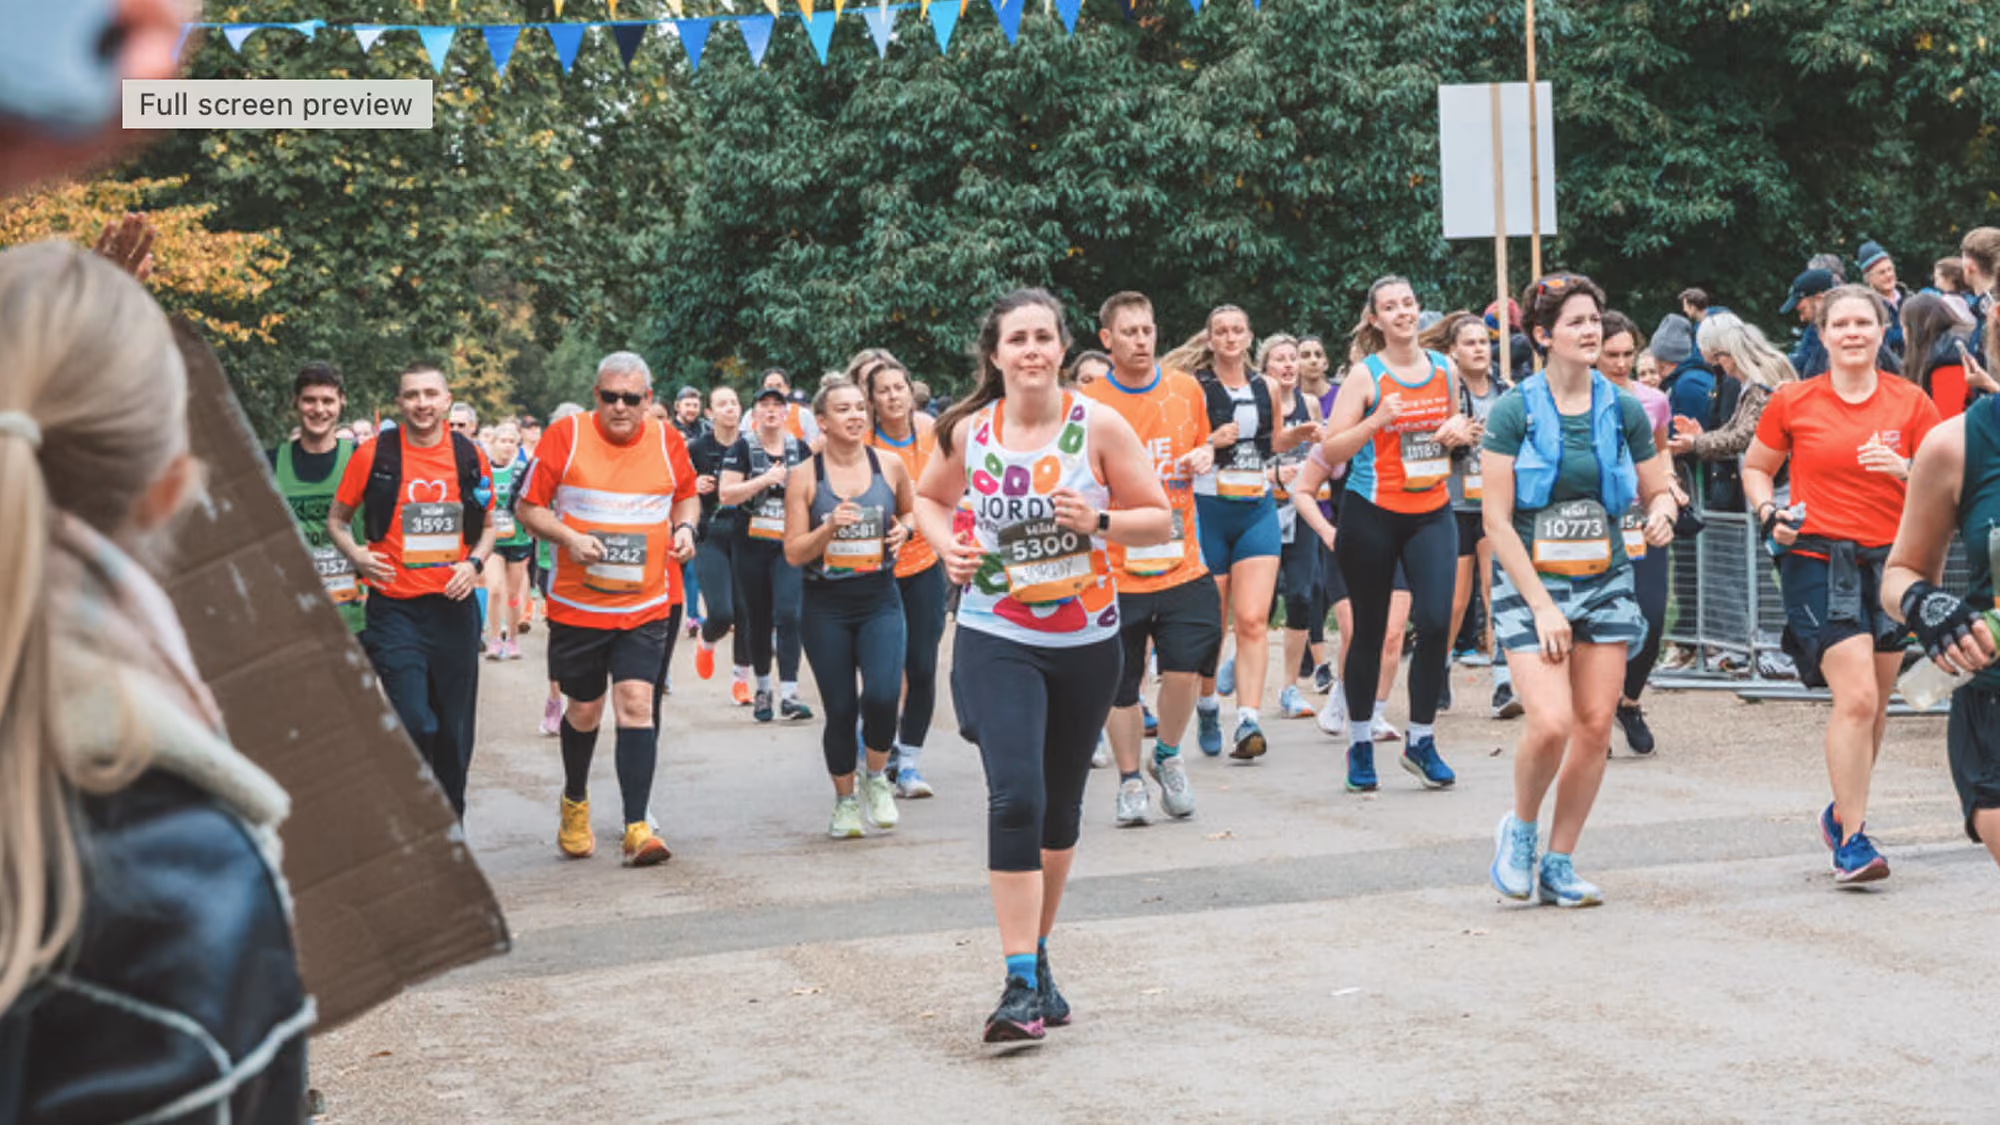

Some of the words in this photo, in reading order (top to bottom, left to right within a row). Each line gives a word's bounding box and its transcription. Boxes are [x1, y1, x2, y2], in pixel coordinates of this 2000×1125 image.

[410, 516, 455, 532] 3593
[1544, 518, 1603, 538] 10773
[1012, 532, 1078, 561] 5300
